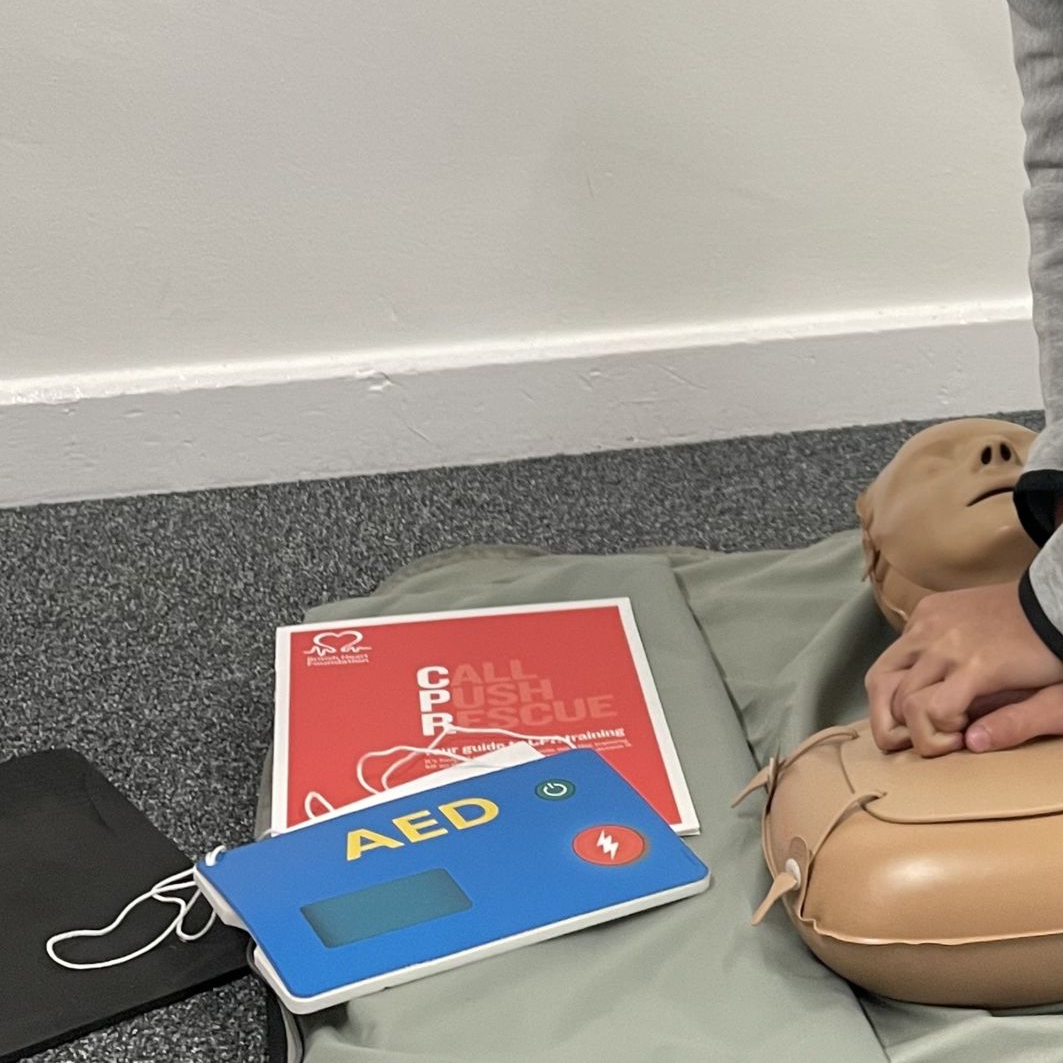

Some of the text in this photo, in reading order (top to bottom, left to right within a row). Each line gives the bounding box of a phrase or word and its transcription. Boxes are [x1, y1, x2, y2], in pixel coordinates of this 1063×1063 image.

[416, 659, 537, 689] CALL
[419, 678, 554, 713] PUSH
[421, 694, 618, 737] RESCUE
[346, 798, 499, 861] AED
